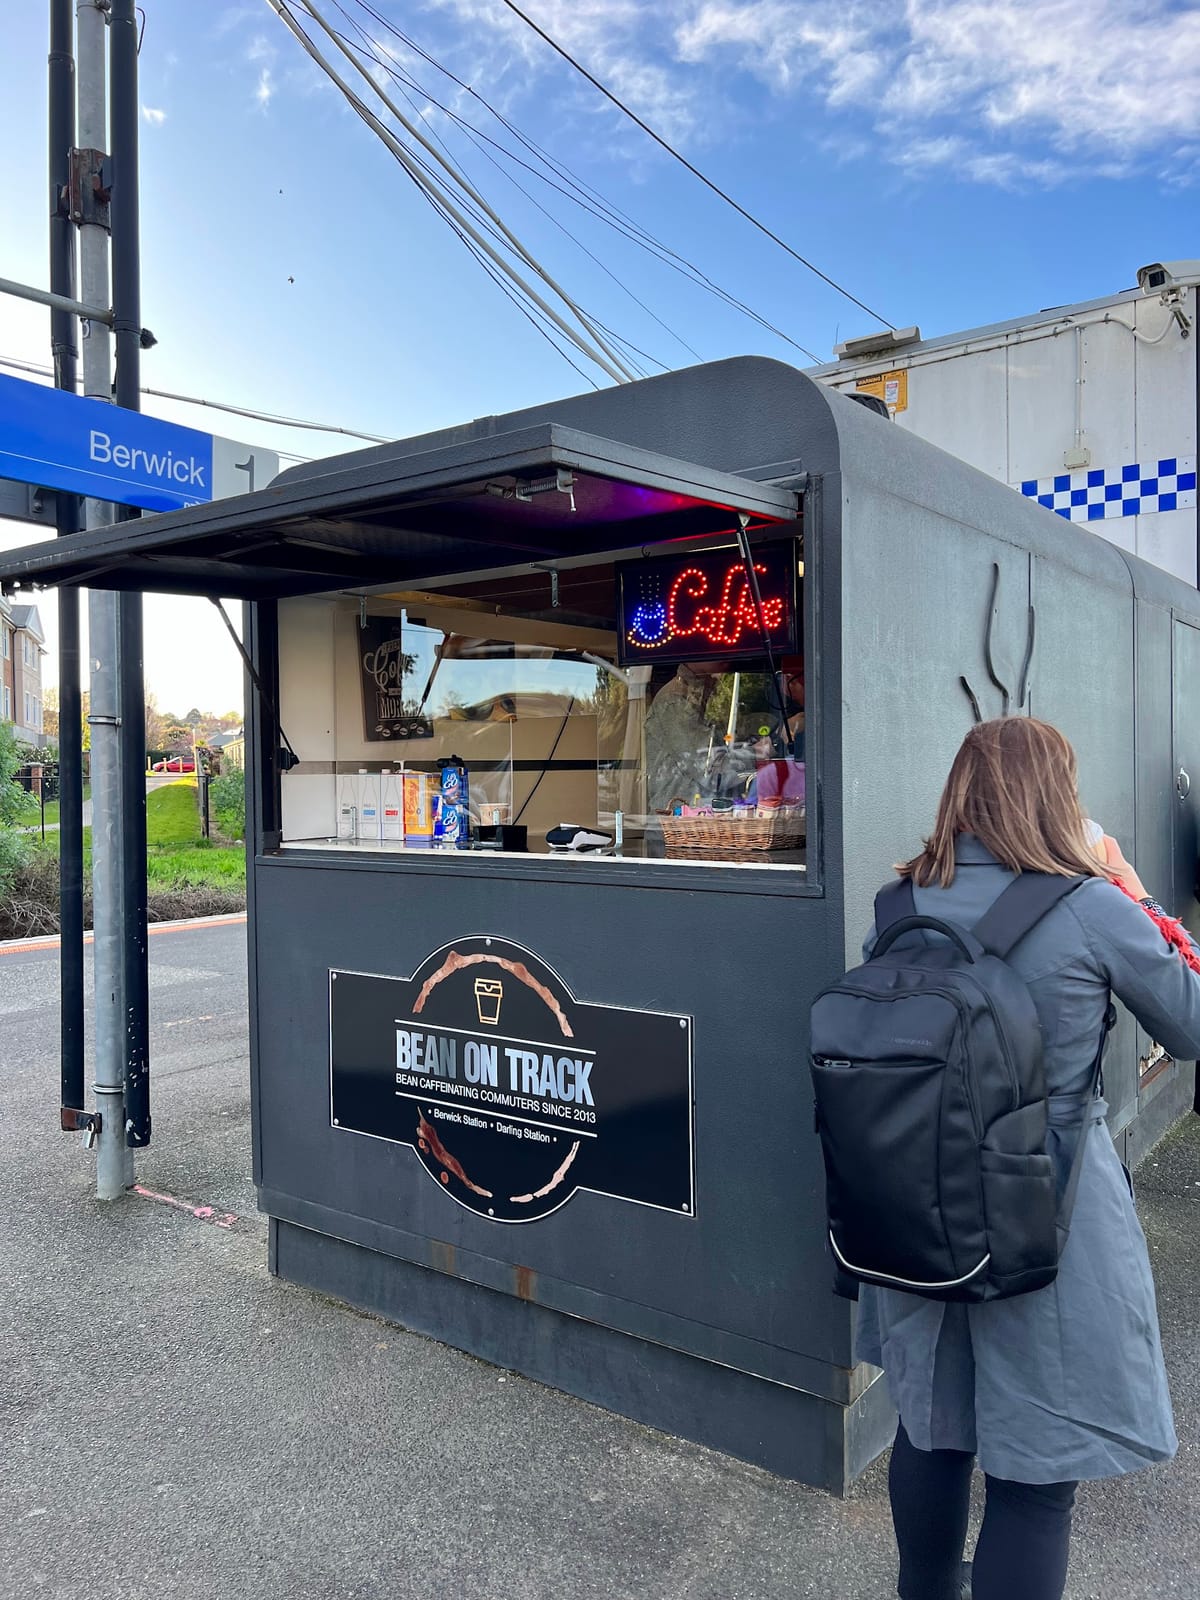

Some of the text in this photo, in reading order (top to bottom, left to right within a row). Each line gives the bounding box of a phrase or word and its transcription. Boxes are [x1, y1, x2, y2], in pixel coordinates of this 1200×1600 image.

[857, 376, 882, 386] WARNING
[90, 430, 205, 488] Berwick
[234, 454, 255, 493] 1
[395, 1029, 595, 1106] BEAN ON TRACK
[395, 1073, 596, 1124] BEAN CAFFEINATING COMMUTERS SINCE 2013
[433, 1108, 550, 1144] Berwick Station Darling Station
